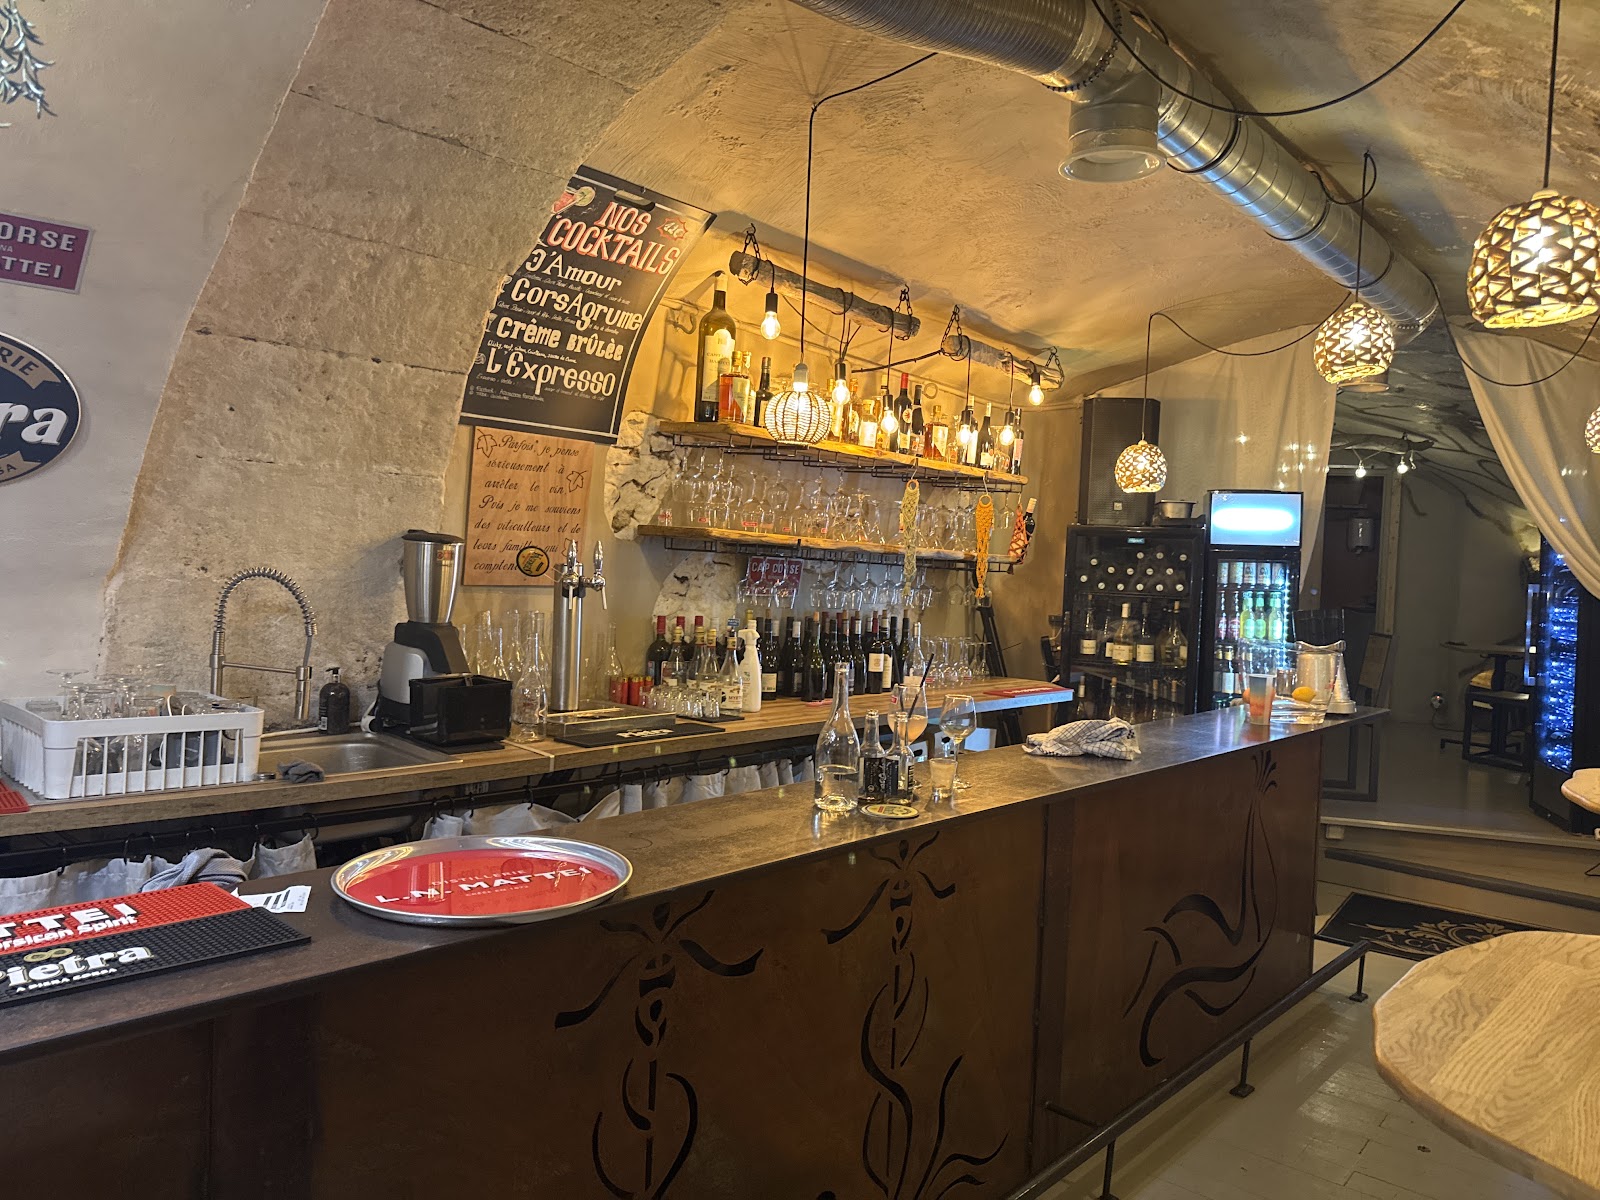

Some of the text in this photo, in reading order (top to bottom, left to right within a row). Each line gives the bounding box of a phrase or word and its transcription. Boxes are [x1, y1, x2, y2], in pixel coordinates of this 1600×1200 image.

[594, 202, 651, 236] NOS
[547, 218, 680, 276] COCKTAILS
[486, 347, 616, 396] L'Expresso
[537, 446, 550, 456] je
[550, 447, 579, 458] pense
[486, 459, 565, 474] sérieusement à
[485, 478, 518, 490] arrêter
[530, 481, 539, 492] le
[508, 501, 520, 512] je
[525, 504, 539, 512] me
[545, 506, 581, 515] souviens
[474, 518, 581, 534] des viticulteurs et de
[772, 563, 800, 575] COSE
[432, 870, 527, 885] DISTILLERIE
[458, 866, 592, 891] MATTEI
[0, 930, 75, 950] rsican
[0, 947, 154, 987] ietra
